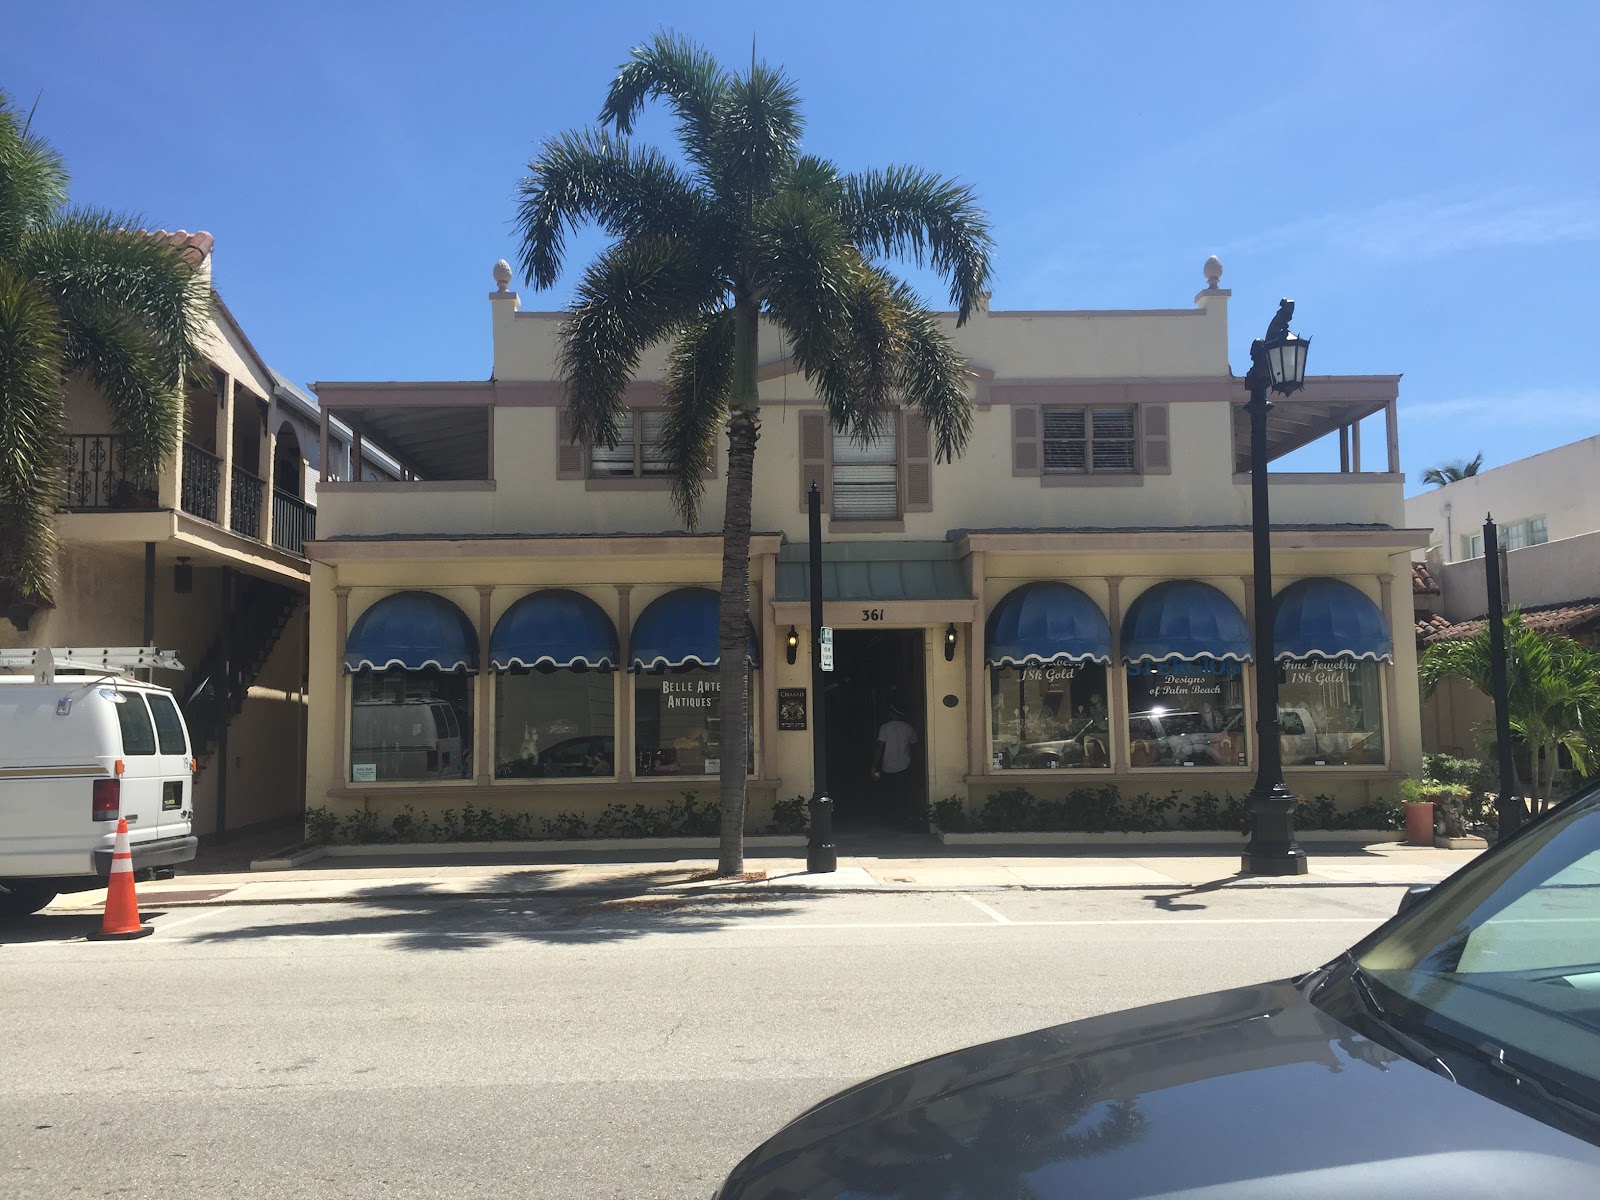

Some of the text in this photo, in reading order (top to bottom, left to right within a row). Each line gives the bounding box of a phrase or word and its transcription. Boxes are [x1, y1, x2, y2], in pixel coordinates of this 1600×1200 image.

[862, 609, 884, 621] 361
[1282, 659, 1357, 672] Fine Jewelry
[1019, 668, 1075, 682] 18k Gold
[1164, 674, 1206, 686] Designs
[1290, 672, 1344, 685] 18k Gold
[662, 680, 721, 694] BELLE ARTE
[1149, 684, 1221, 697] of Palm Beach
[667, 695, 712, 708] ANTIQUES
